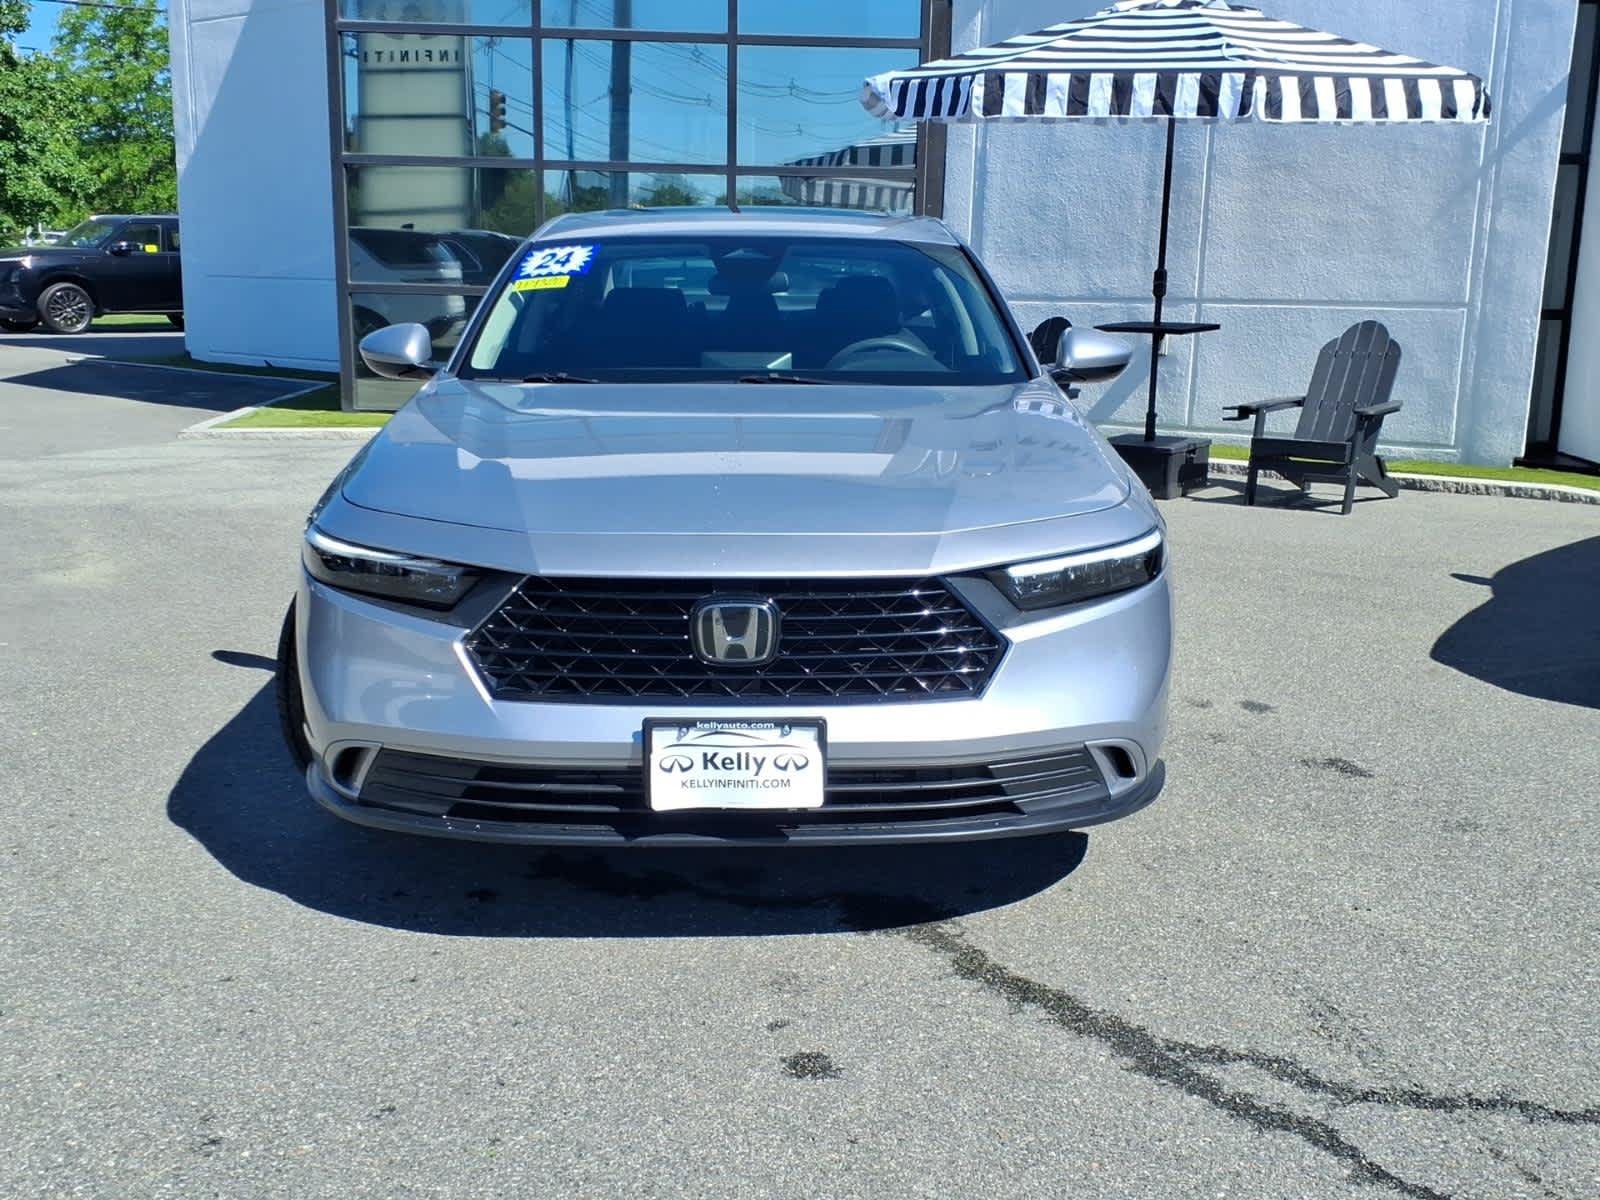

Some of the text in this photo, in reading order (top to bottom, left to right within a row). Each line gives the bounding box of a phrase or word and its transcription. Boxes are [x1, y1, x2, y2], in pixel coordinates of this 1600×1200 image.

[534, 250, 576, 271] 24
[696, 720, 775, 731] kellyauto.com
[702, 751, 767, 777] Kelly
[680, 778, 792, 790] KELLYINFINITI.COM
